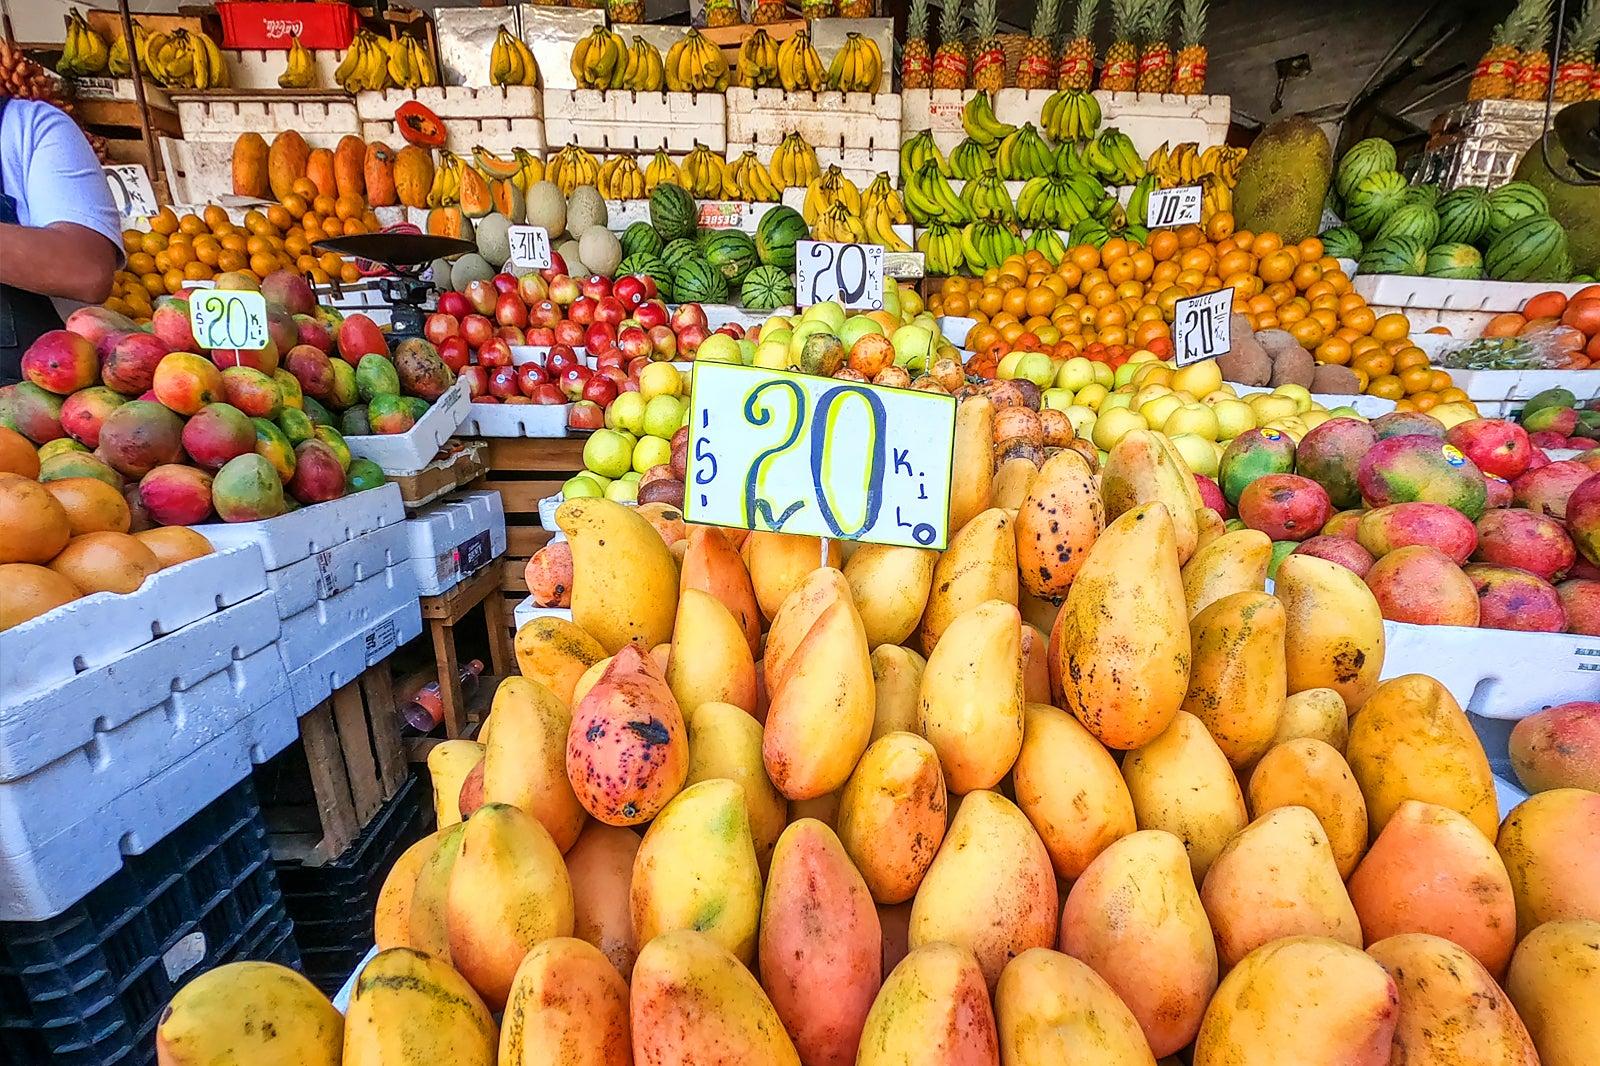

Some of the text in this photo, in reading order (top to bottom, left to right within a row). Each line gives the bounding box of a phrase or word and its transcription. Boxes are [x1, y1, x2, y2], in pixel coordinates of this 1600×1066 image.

[1155, 195, 1180, 225] 10
[515, 232, 536, 260] 30
[811, 243, 867, 305] 20
[206, 297, 249, 347] 20
[1185, 306, 1214, 360] 20
[744, 379, 887, 541] 20
